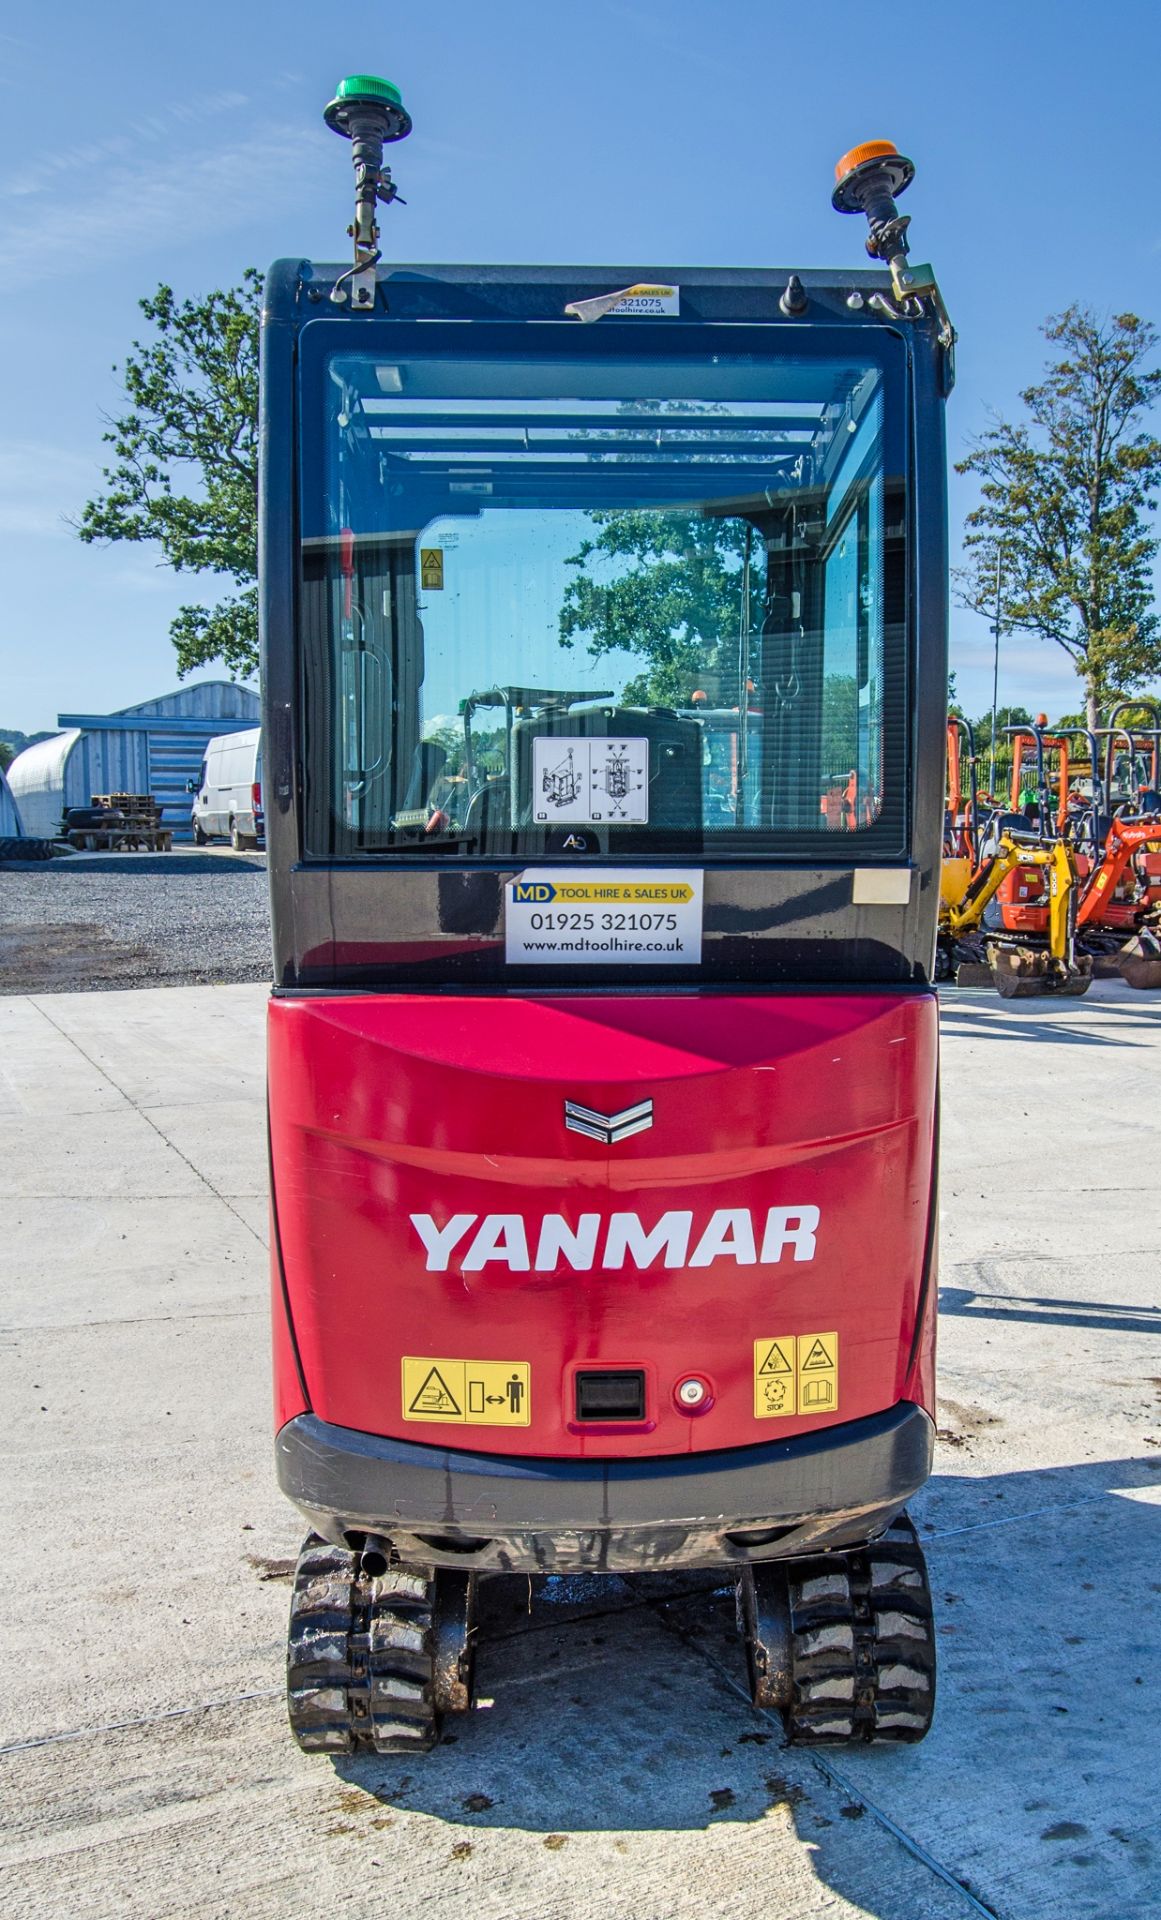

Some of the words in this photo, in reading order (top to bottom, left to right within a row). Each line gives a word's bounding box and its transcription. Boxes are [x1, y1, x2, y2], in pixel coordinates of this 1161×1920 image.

[620, 299, 662, 307] 321075
[516, 885, 550, 901] MD
[560, 888, 591, 898] TOOL
[594, 888, 620, 898] HIRE
[623, 888, 631, 898] &
[635, 888, 667, 898] SALES
[671, 888, 687, 898] UK
[530, 913, 594, 930] 01925
[601, 913, 677, 930] 321075
[523, 937, 684, 951] www.mdtoolhire.co.uk
[409, 1204, 821, 1272] YANMAR
[766, 1403, 784, 1412] STOP
